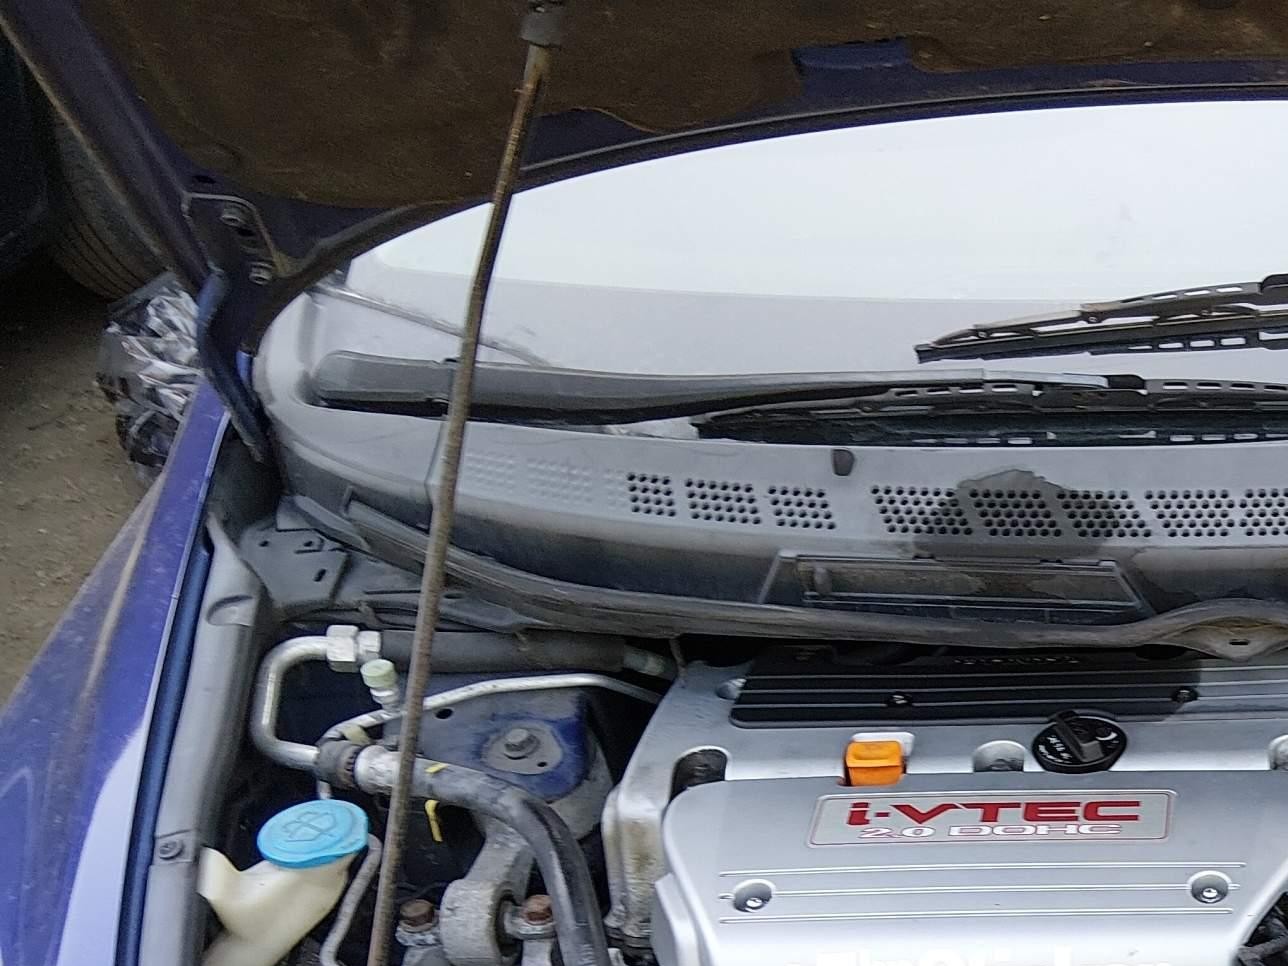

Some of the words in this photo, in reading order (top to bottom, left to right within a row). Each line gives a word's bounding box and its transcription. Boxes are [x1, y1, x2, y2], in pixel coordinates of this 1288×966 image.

[847, 801, 1141, 825] i-VTEC
[858, 826, 935, 839] 2.0
[947, 823, 1122, 837] DOHC
